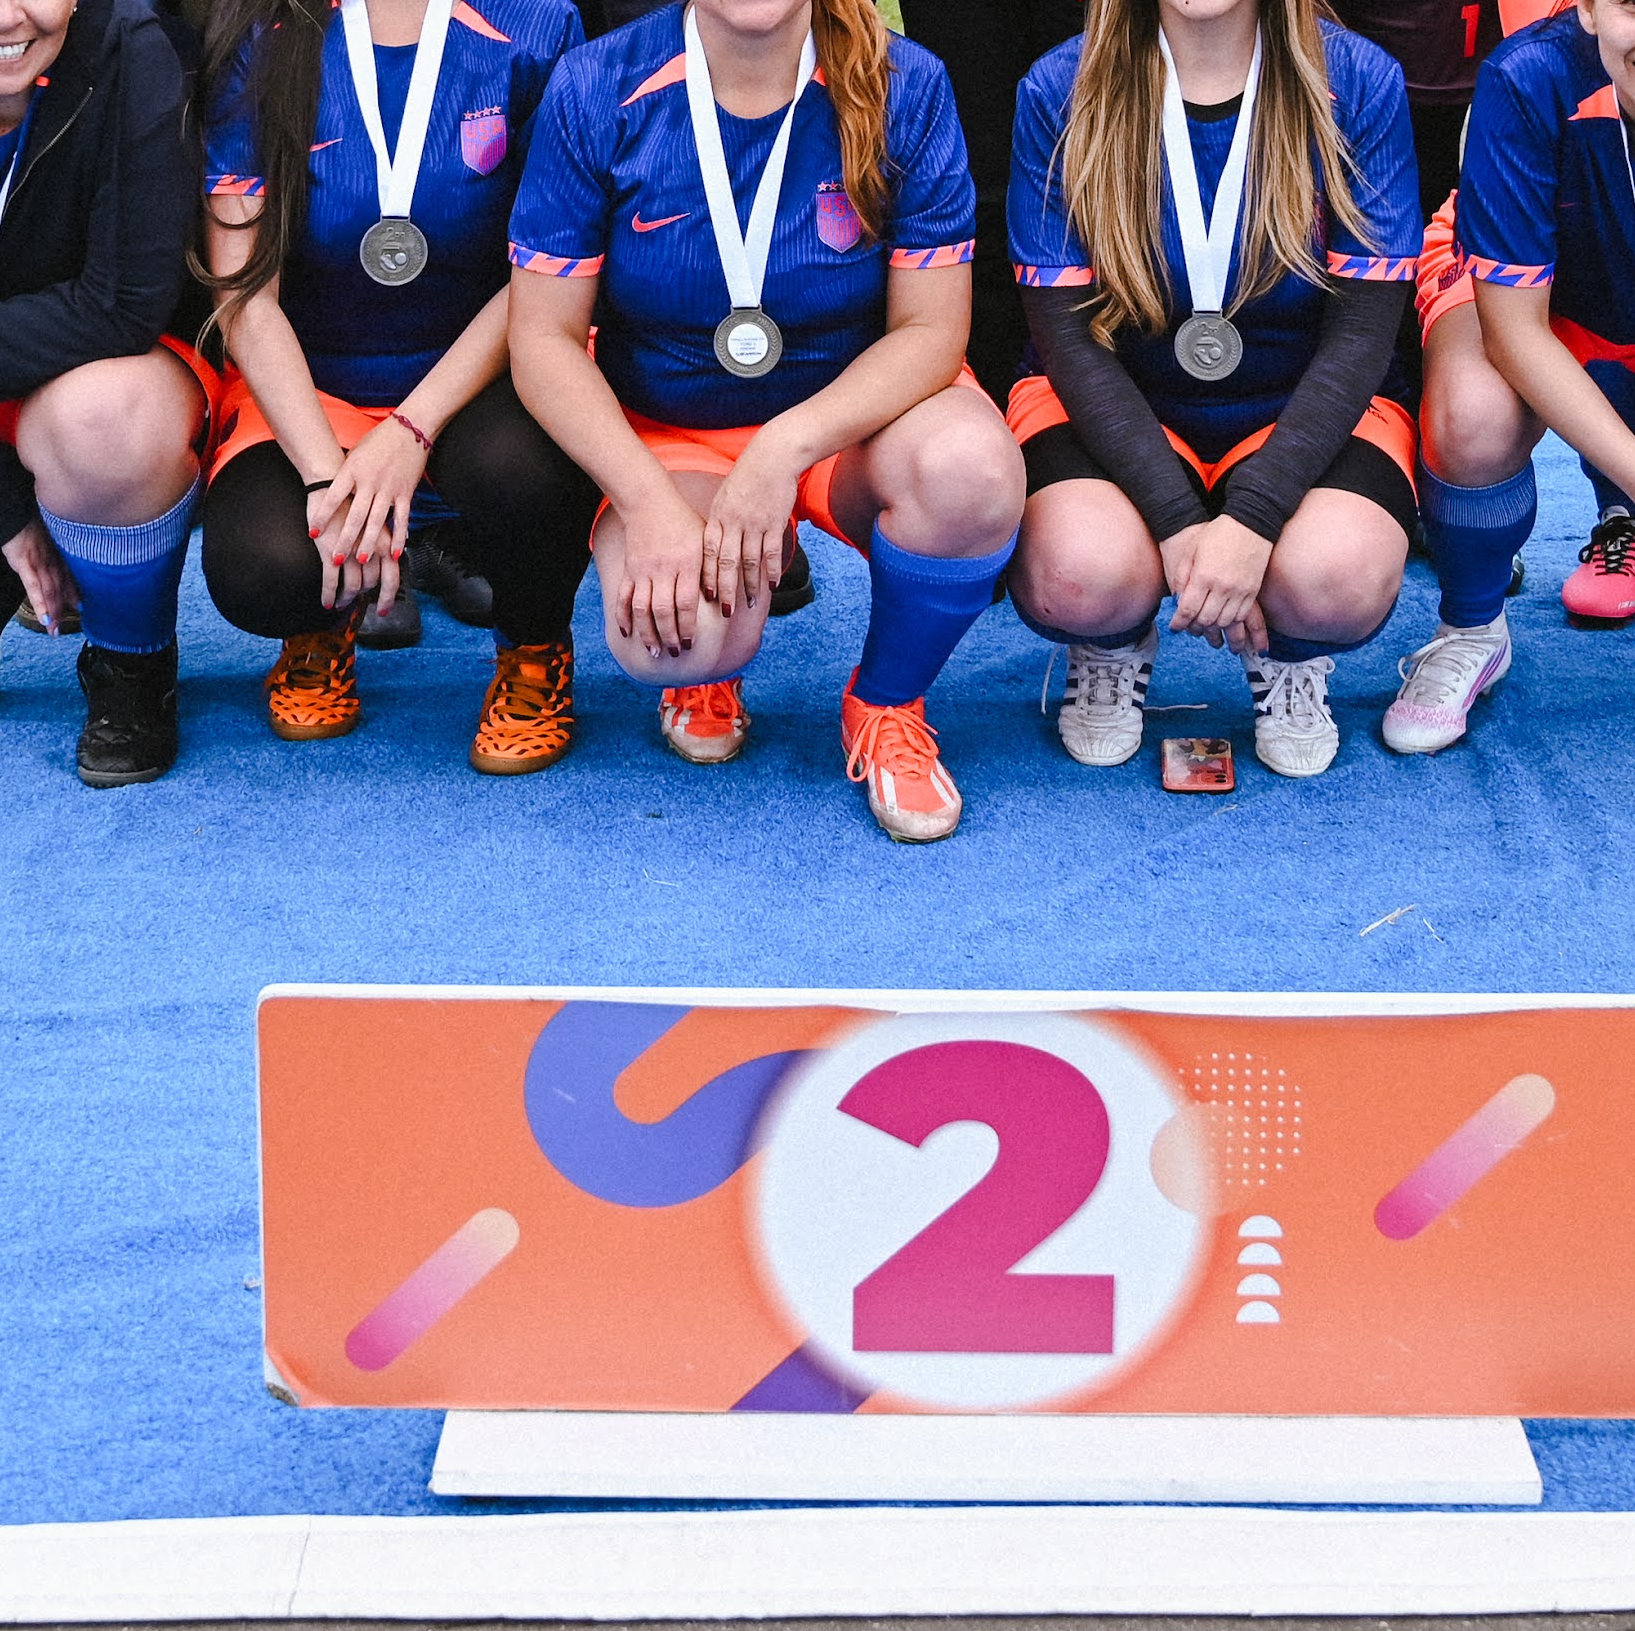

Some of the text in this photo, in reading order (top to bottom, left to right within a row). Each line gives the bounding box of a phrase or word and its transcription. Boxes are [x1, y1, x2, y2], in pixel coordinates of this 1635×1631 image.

[1461, 3, 1480, 58] 1
[465, 119, 502, 142] USA
[836, 1039, 1114, 1354] 2
